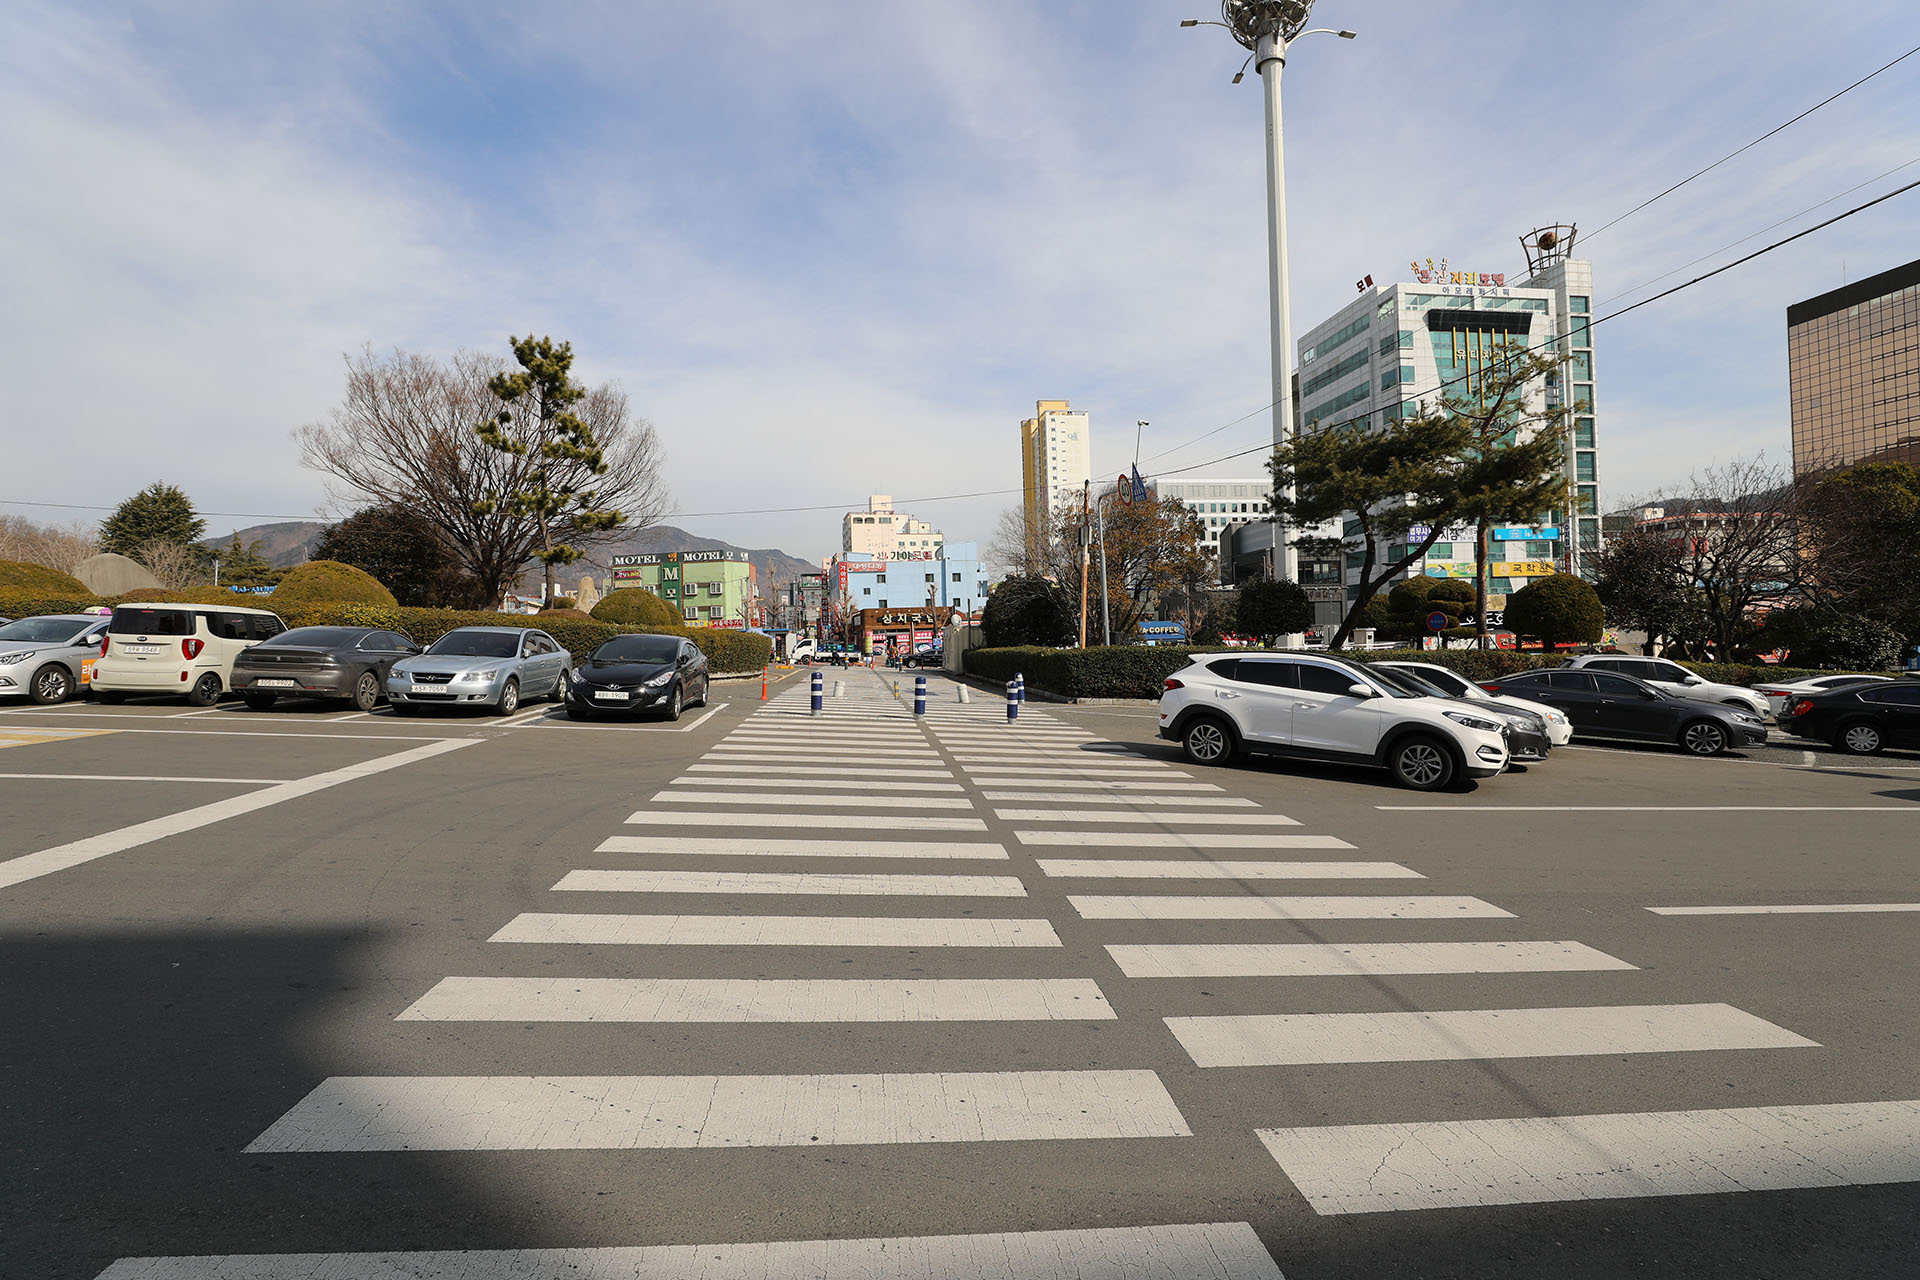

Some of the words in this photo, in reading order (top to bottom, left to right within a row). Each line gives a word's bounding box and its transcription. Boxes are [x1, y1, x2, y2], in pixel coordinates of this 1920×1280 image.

[614, 555, 661, 566] MOTEL
[683, 551, 724, 561] MOTEL
[663, 567, 679, 581] M
[1149, 626, 1179, 634] COFFEE
